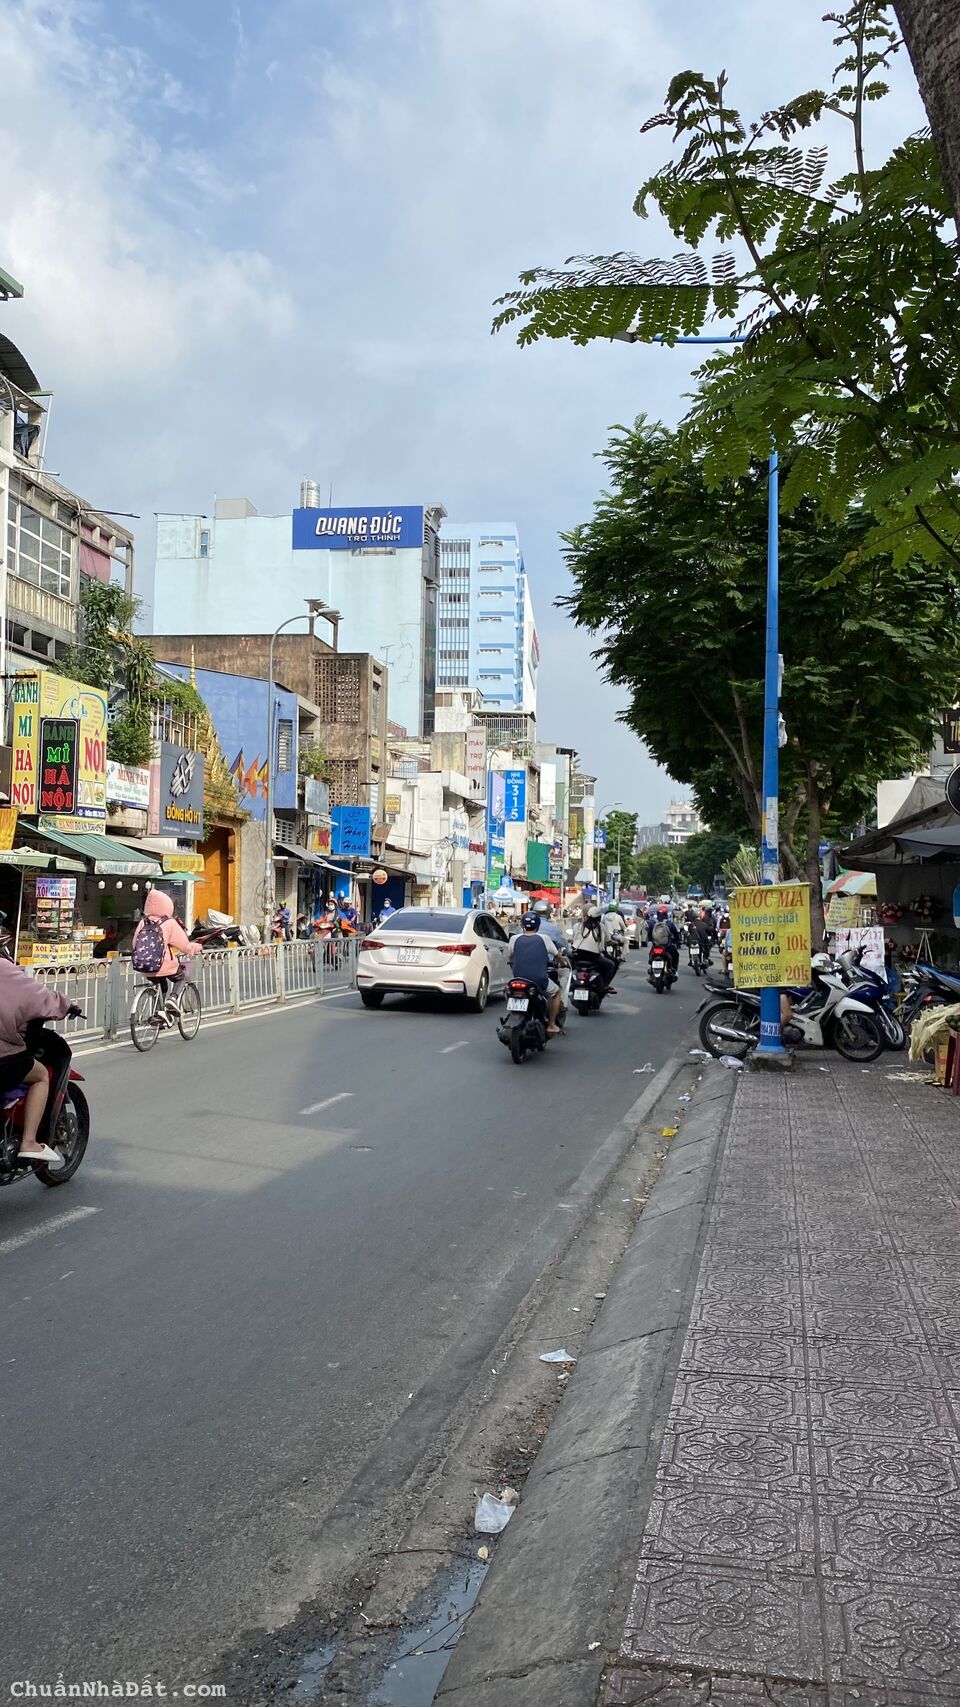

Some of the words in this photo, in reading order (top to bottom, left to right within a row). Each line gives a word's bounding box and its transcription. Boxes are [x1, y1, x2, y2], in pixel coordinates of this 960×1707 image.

[315, 516, 368, 536] QUANG
[369, 511, 403, 534] ĐỨC
[18, 709, 32, 738] MÌ
[43, 722, 75, 741] BÁNH
[15, 743, 33, 772] HÀ
[46, 742, 71, 763] MÌ
[84, 728, 106, 781] NỘI
[43, 765, 71, 786] HÀ
[12, 777, 35, 812] NỘI
[41, 787, 72, 812] NỘI
[166, 801, 184, 822] ĐỒNG
[184, 803, 194, 823] HỒ
[194, 810, 202, 824] HT
[733, 886, 773, 909] NƯỚC
[738, 914, 775, 927] Nguyên
[739, 931, 761, 942] SIÊU
[763, 931, 776, 941] TO
[786, 934, 808, 951] 10k
[760, 962, 776, 971] cam
[785, 963, 809, 981] 20k
